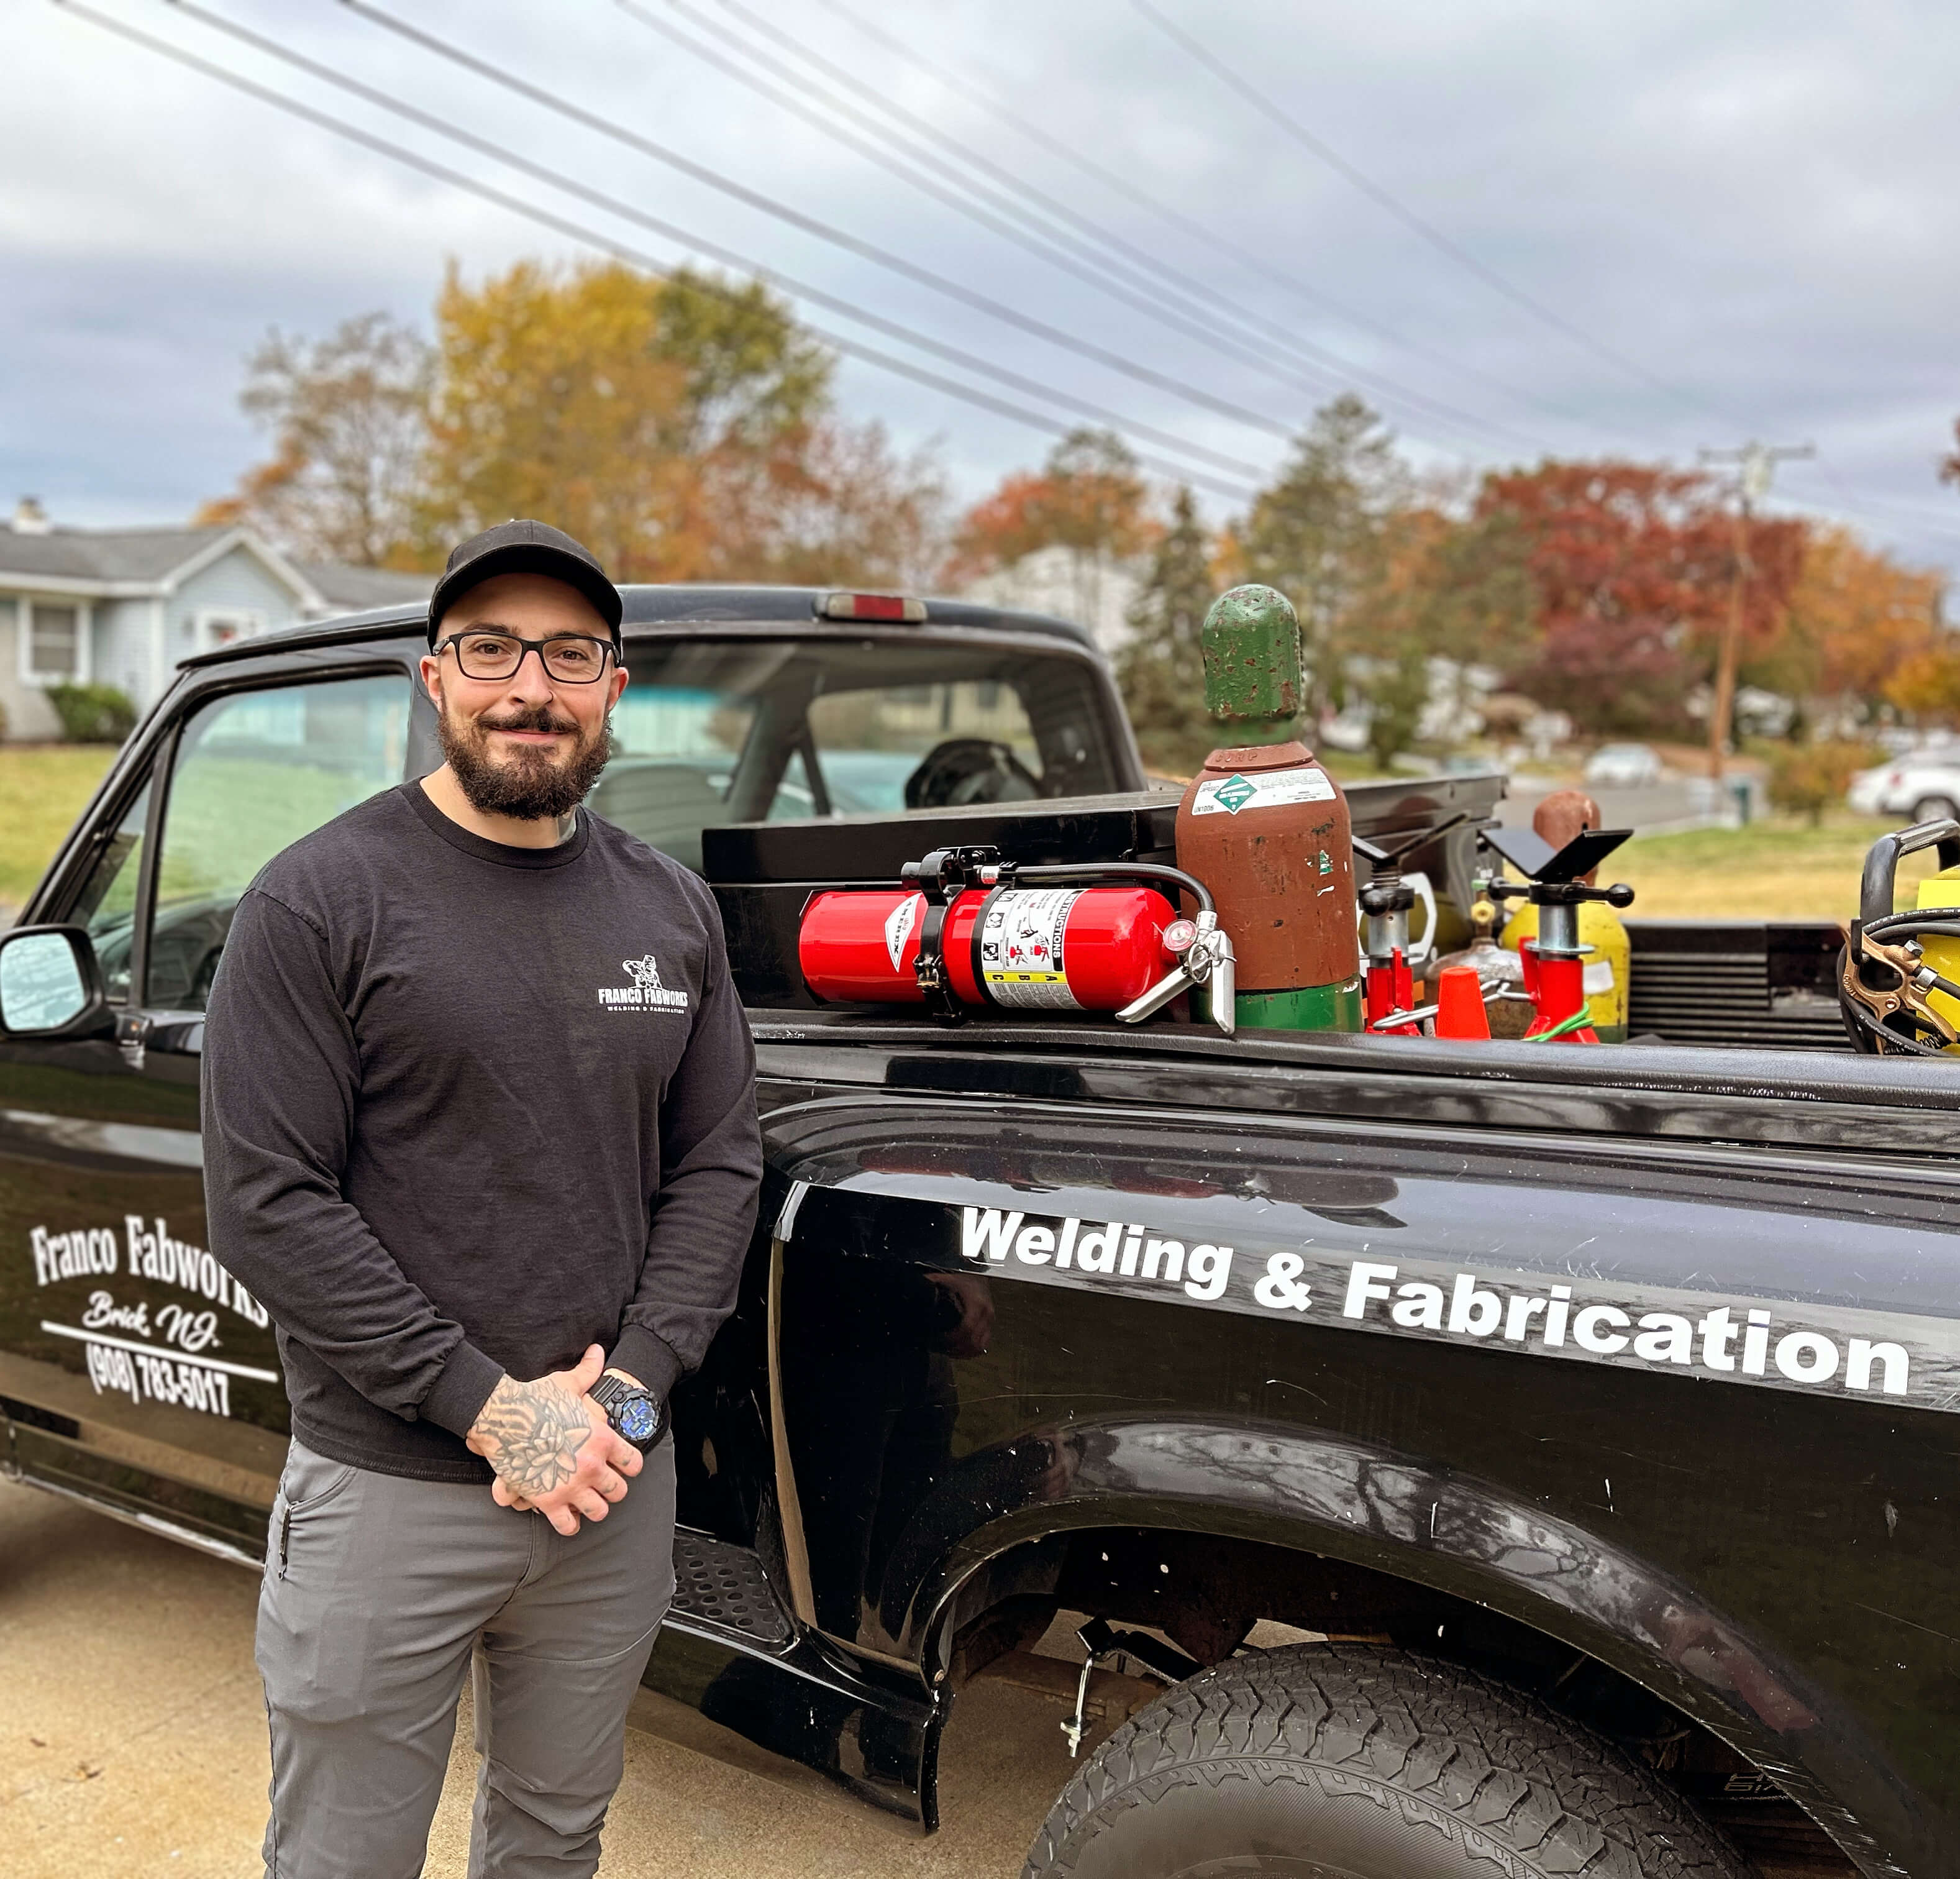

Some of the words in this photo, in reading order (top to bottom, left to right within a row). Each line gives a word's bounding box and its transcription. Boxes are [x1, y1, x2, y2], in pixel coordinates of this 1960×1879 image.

[1052, 893, 1076, 958] INSTRUCTIONS
[598, 989, 642, 1004] FRANCO
[644, 989, 688, 1007] FABWORKS
[649, 1006, 685, 1014] FABRICATION
[30, 1225, 118, 1286] Franco
[959, 1207, 1234, 1302] Welding
[1254, 1252, 1313, 1312] &
[1343, 1261, 1911, 1396] Fabrication
[86, 1342, 139, 1404] (908)
[135, 1354, 230, 1417] 783-5017
